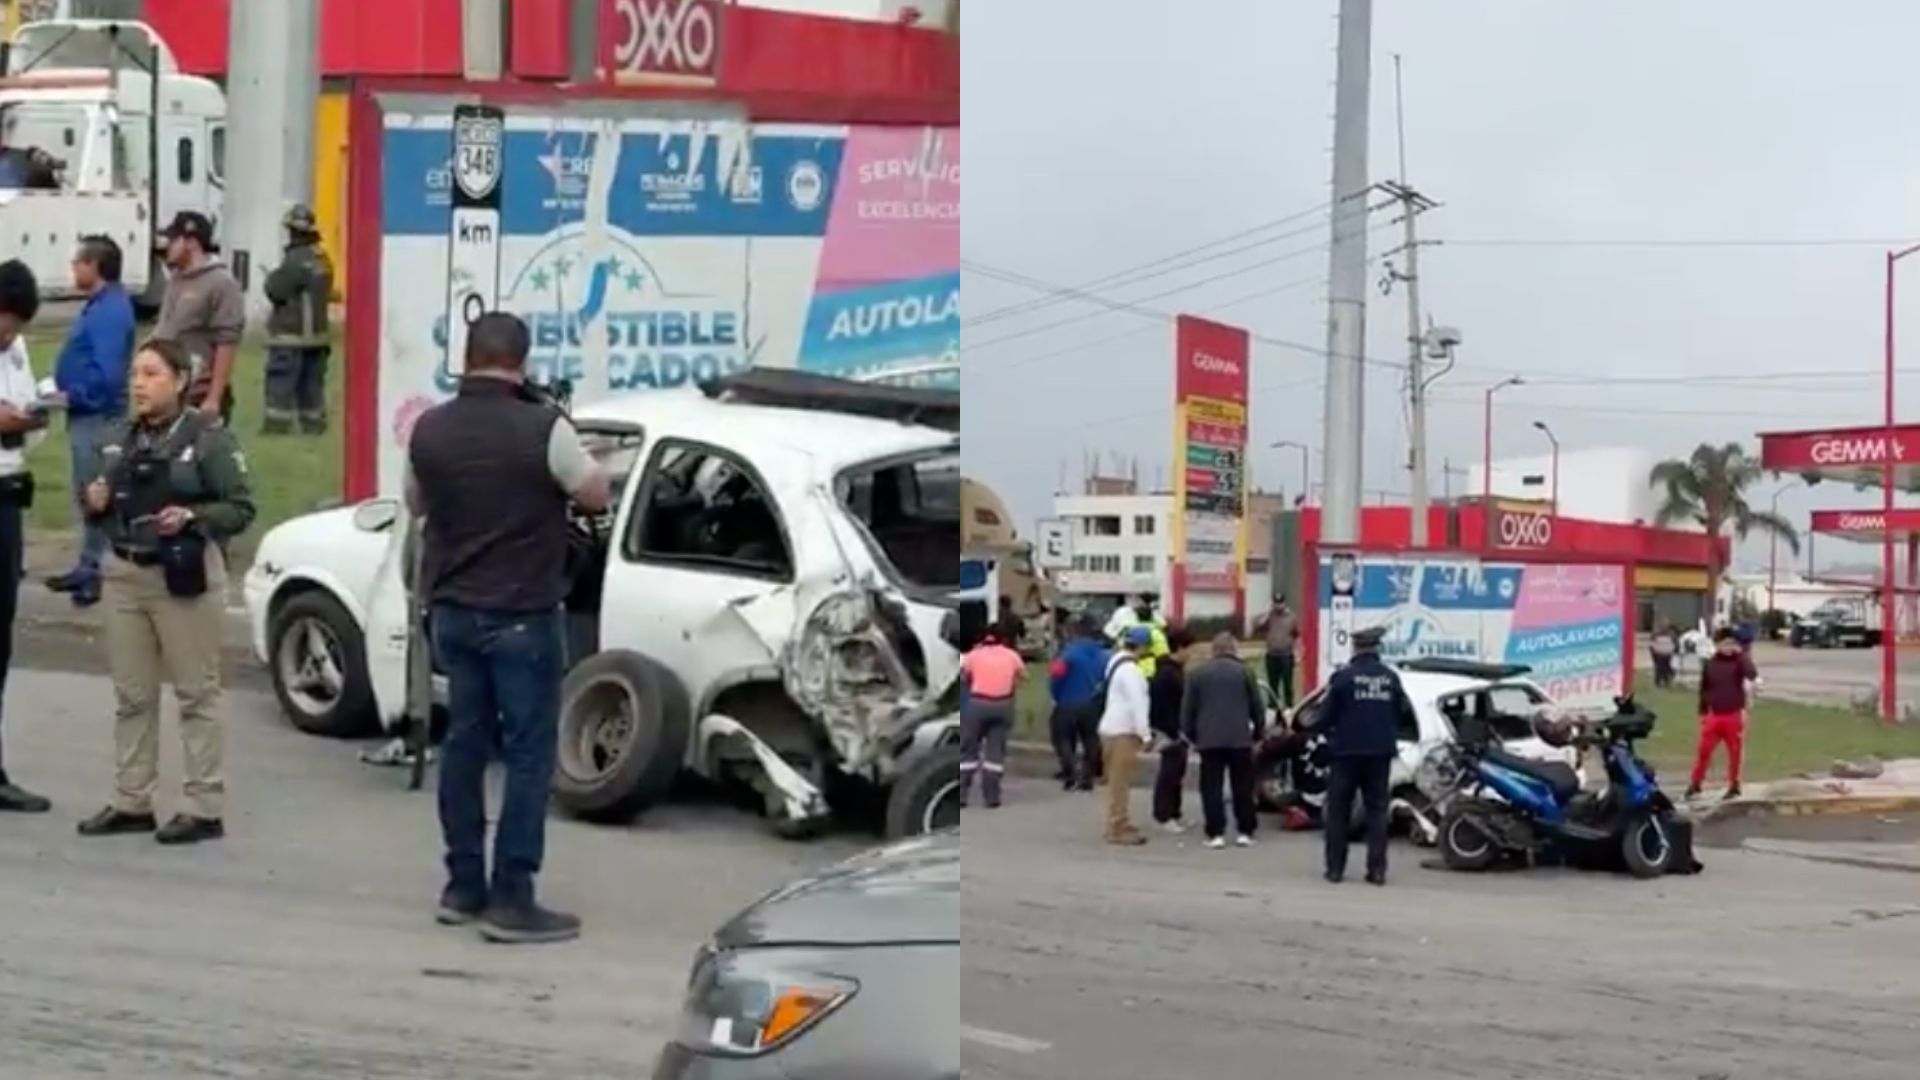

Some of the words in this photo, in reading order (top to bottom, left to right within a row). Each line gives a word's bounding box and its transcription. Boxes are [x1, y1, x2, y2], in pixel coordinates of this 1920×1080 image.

[459, 217, 493, 242] km
[1501, 511, 1551, 547] OXXO
[1516, 623, 1618, 654] AUTOLAVADO
